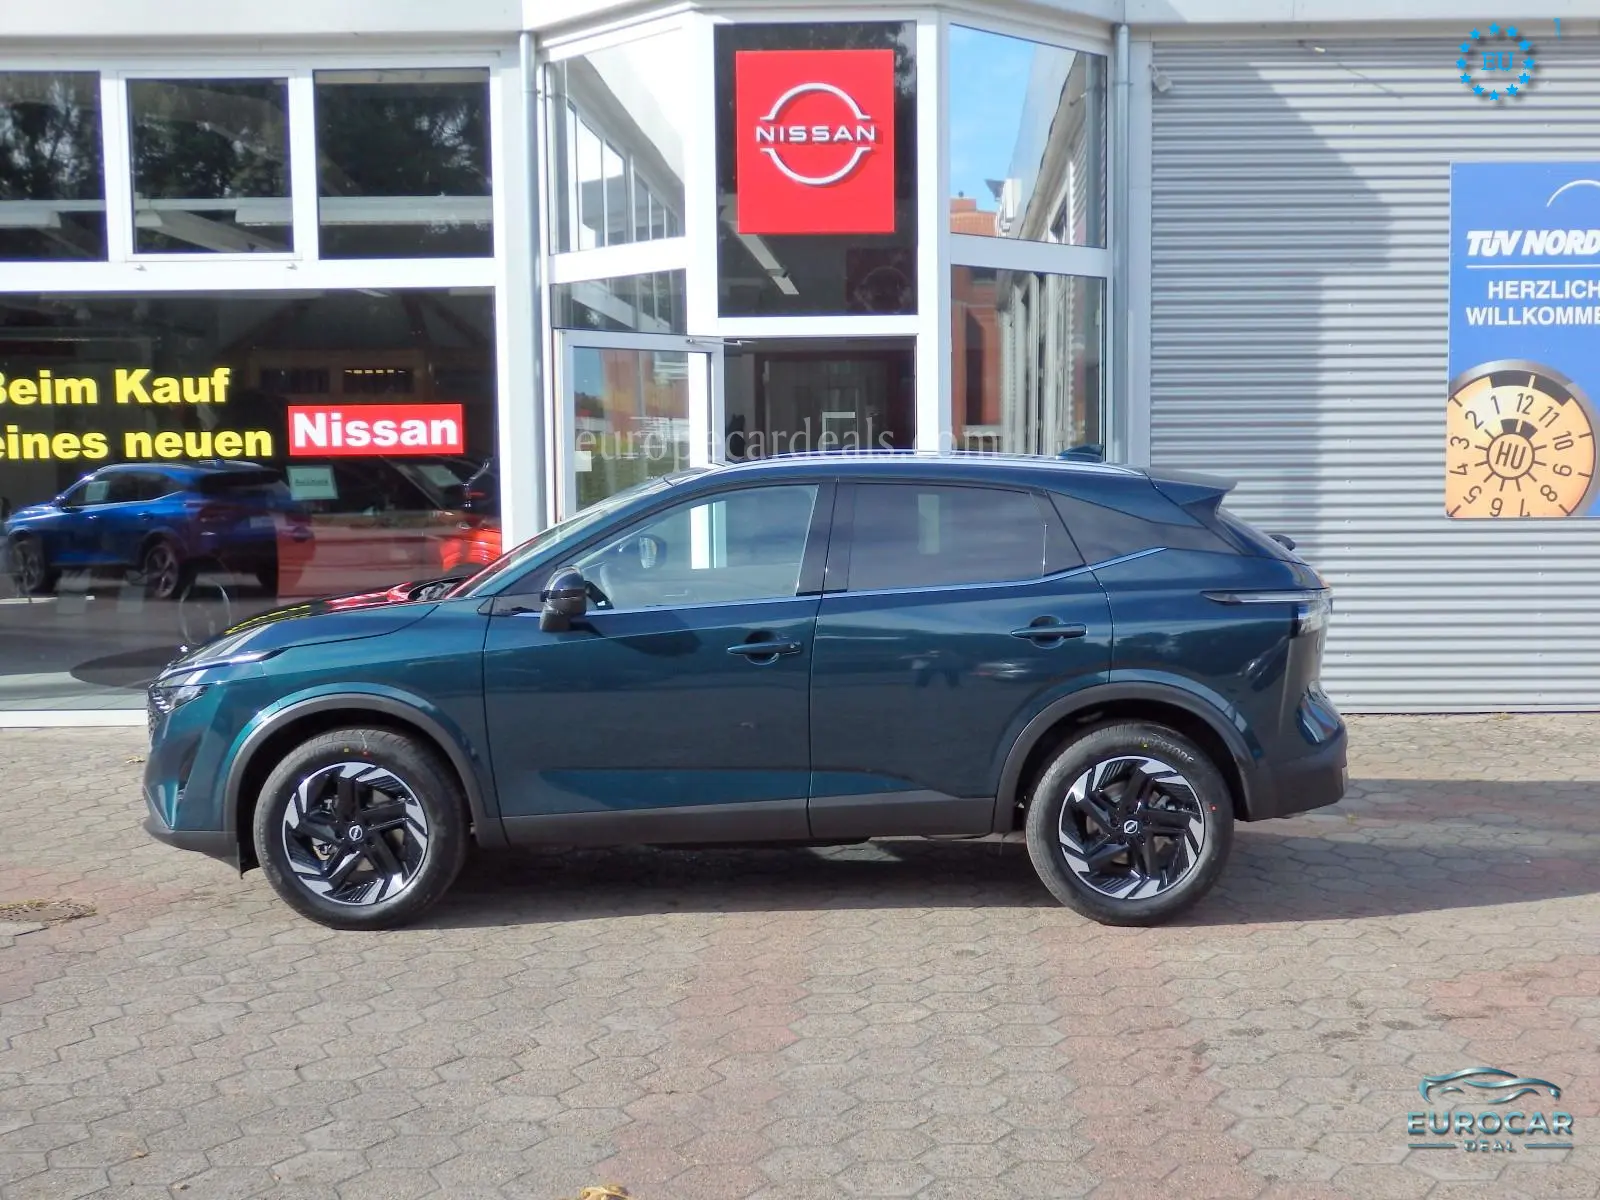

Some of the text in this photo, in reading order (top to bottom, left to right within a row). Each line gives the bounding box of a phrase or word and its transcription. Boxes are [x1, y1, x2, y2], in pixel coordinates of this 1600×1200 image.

[756, 125, 876, 143] NISSAN
[1521, 229, 1600, 256] NORD
[1488, 280, 1600, 299] HERZLICH
[0, 367, 231, 405] eim Kauf
[1516, 393, 1534, 415] 12
[1465, 410, 1484, 430] 2
[1538, 405, 1560, 428] 11
[0, 411, 459, 460] ines neuen Nissan
[1450, 435, 1470, 450] 3
[1552, 431, 1574, 451] 10
[1495, 441, 1527, 470] HU
[1449, 463, 1469, 476] 4
[1463, 485, 1482, 504] 5
[1540, 484, 1558, 502] 8
